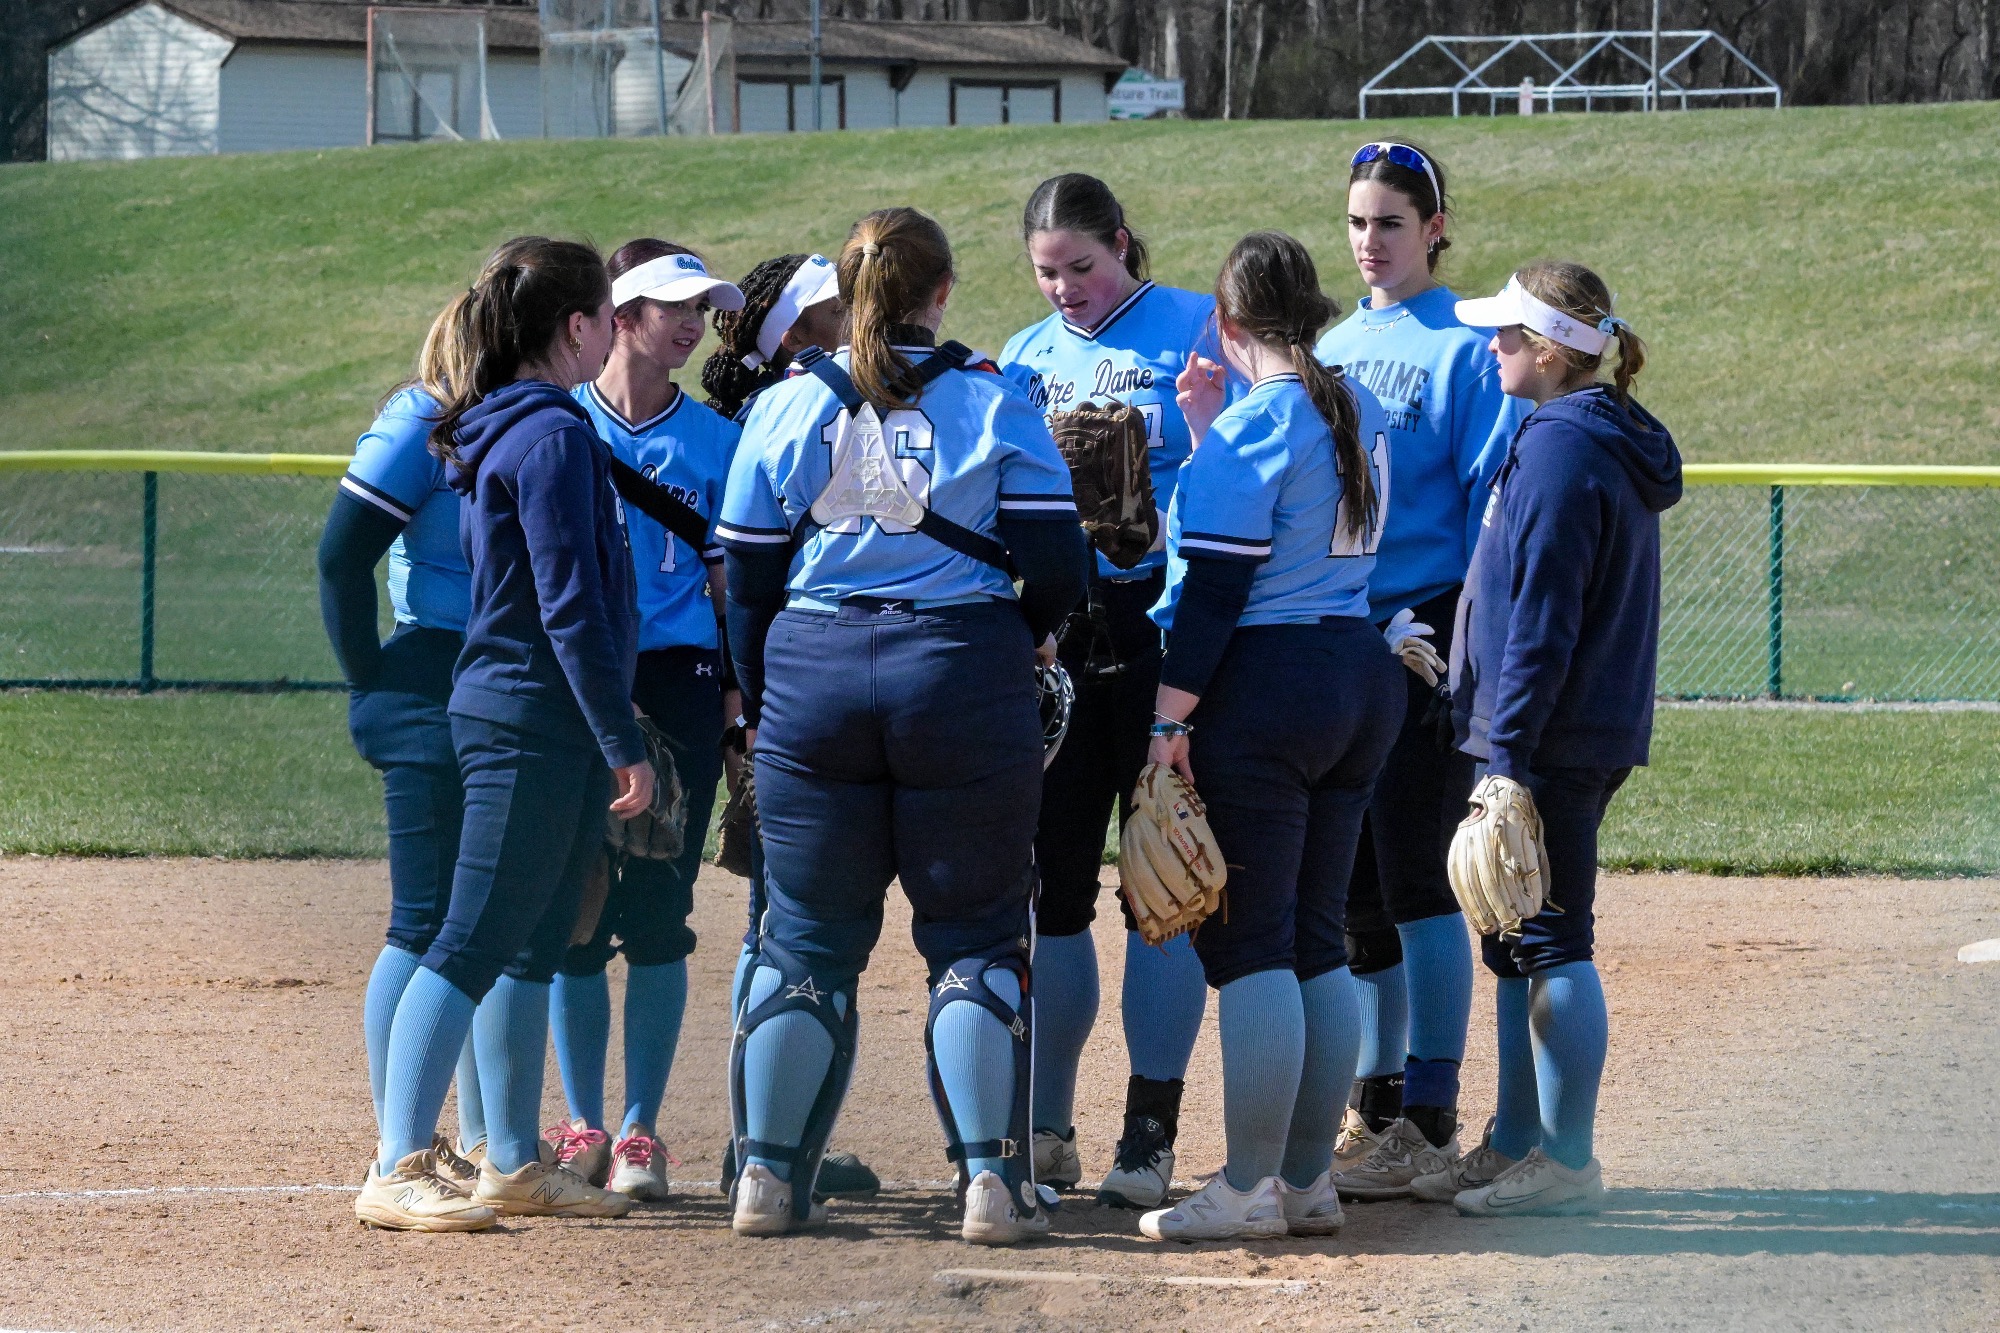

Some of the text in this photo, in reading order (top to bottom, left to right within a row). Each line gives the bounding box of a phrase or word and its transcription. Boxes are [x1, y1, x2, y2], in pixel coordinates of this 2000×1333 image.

[1026, 357, 1154, 410] Notre Dame
[1367, 359, 1430, 411] DAME
